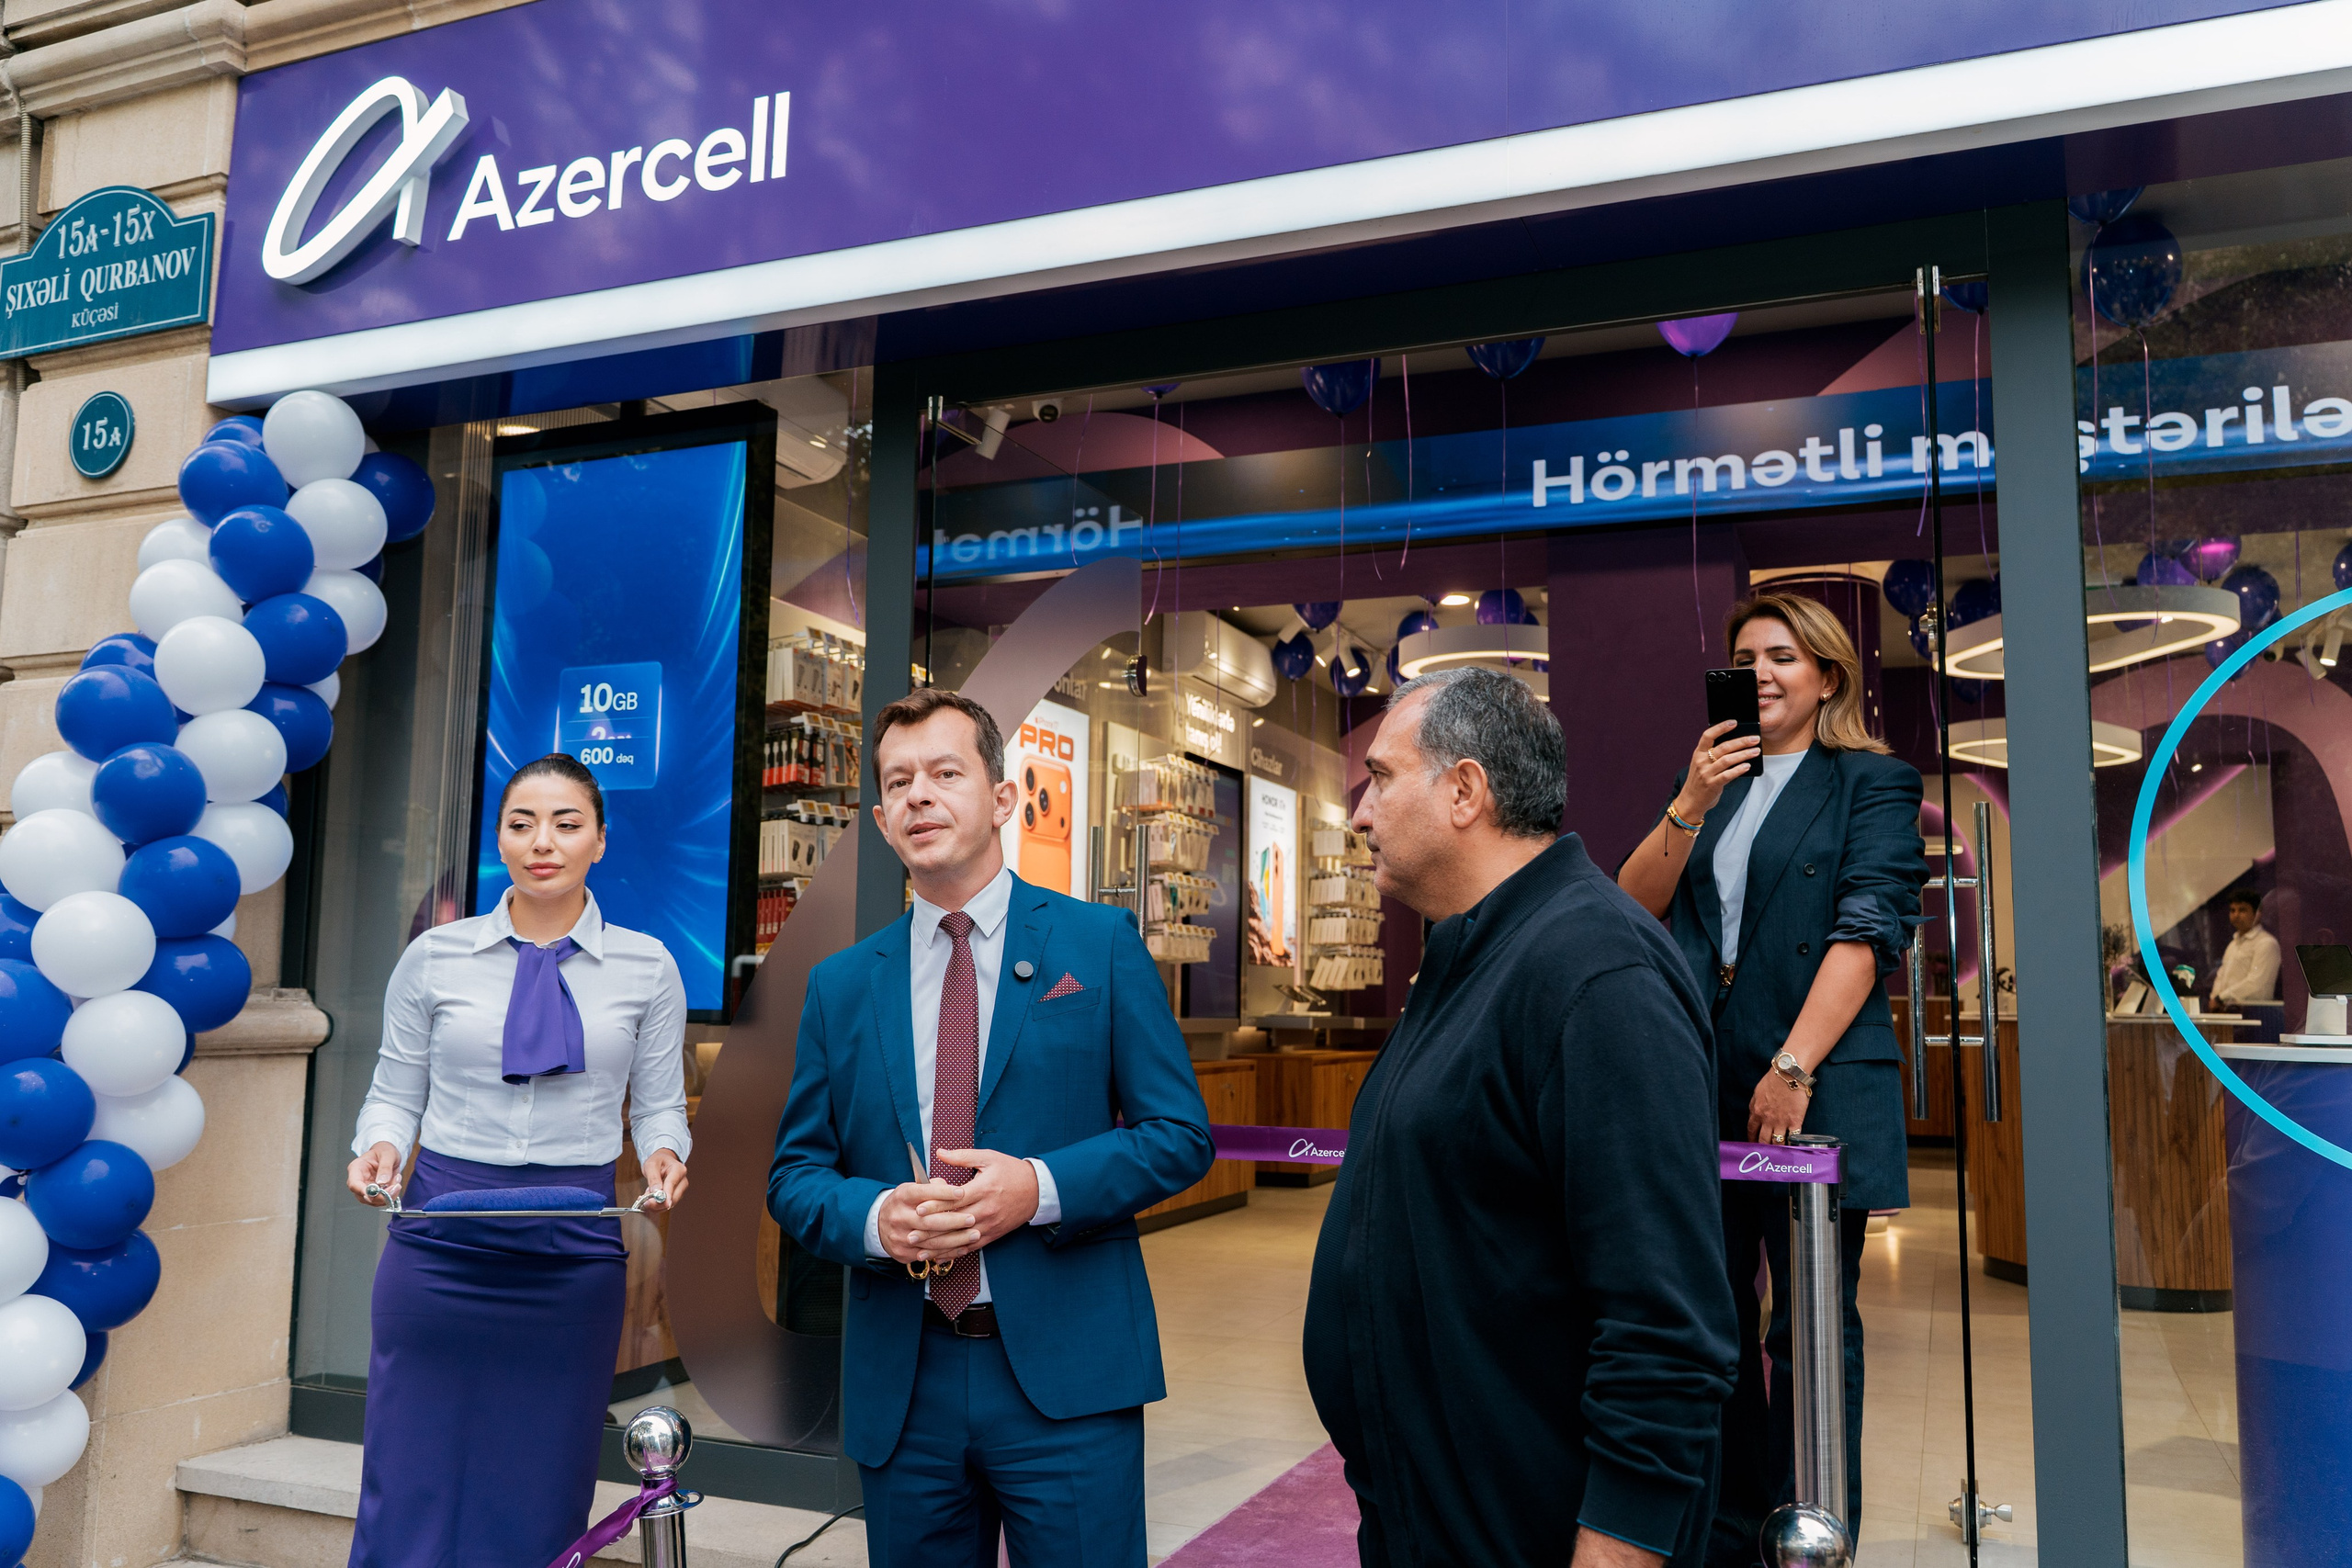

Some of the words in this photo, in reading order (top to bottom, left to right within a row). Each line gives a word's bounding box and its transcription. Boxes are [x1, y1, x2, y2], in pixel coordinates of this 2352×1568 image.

[447, 90, 791, 242] Azercell
[5, 267, 71, 319] ŞIXƏLİ
[80, 246, 197, 302] QURBANOV
[71, 302, 119, 329] KÜÇƏSİ
[82, 417, 121, 450] 15A
[1532, 423, 1883, 508] Hörmətli
[580, 747, 614, 765] 600
[616, 753, 634, 765] dəq
[1019, 723, 1074, 761] PRO
[1310, 1147, 1347, 1157] Azerce
[1765, 1162, 1813, 1174] Azercell
